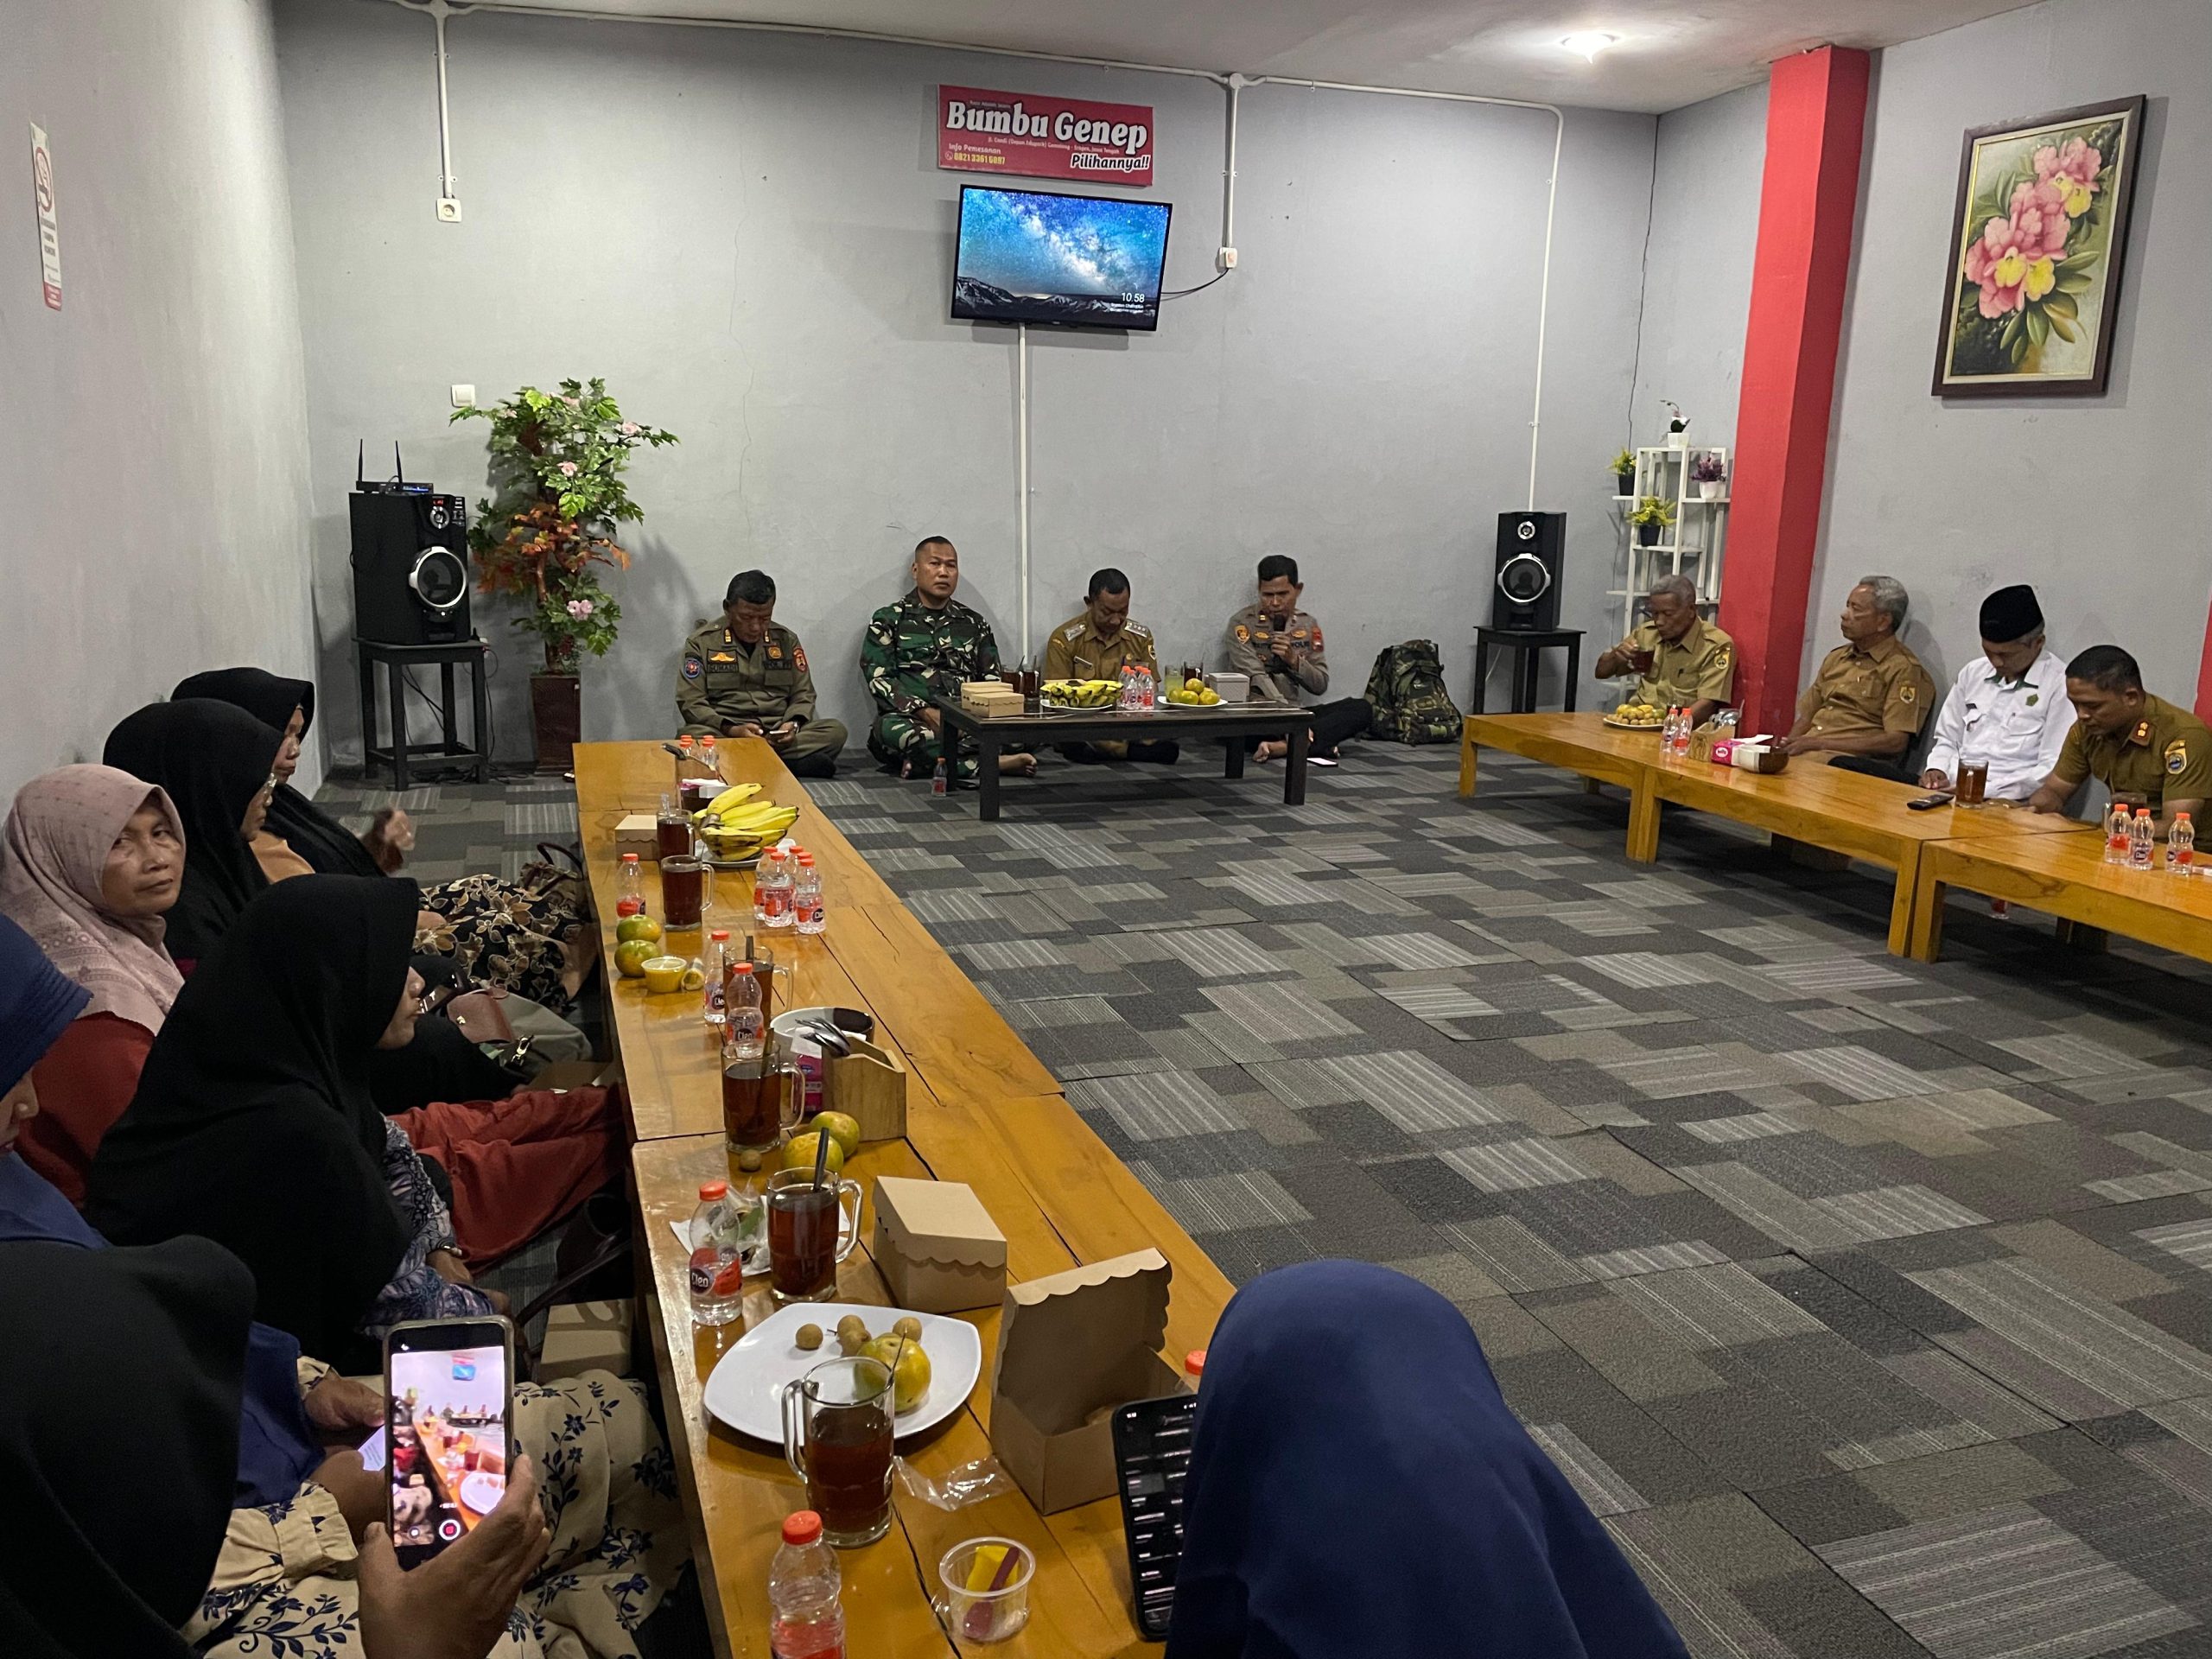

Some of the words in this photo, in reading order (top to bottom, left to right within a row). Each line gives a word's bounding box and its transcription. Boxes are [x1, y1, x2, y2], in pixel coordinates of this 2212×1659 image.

[946, 101, 1048, 137] Bumbu
[1054, 111, 1147, 155] Genep
[949, 143, 963, 152] Info
[963, 143, 1001, 154] Pemesanan
[1071, 154, 1149, 171] Pilihannya!!
[1122, 292, 1145, 302] 10.58
